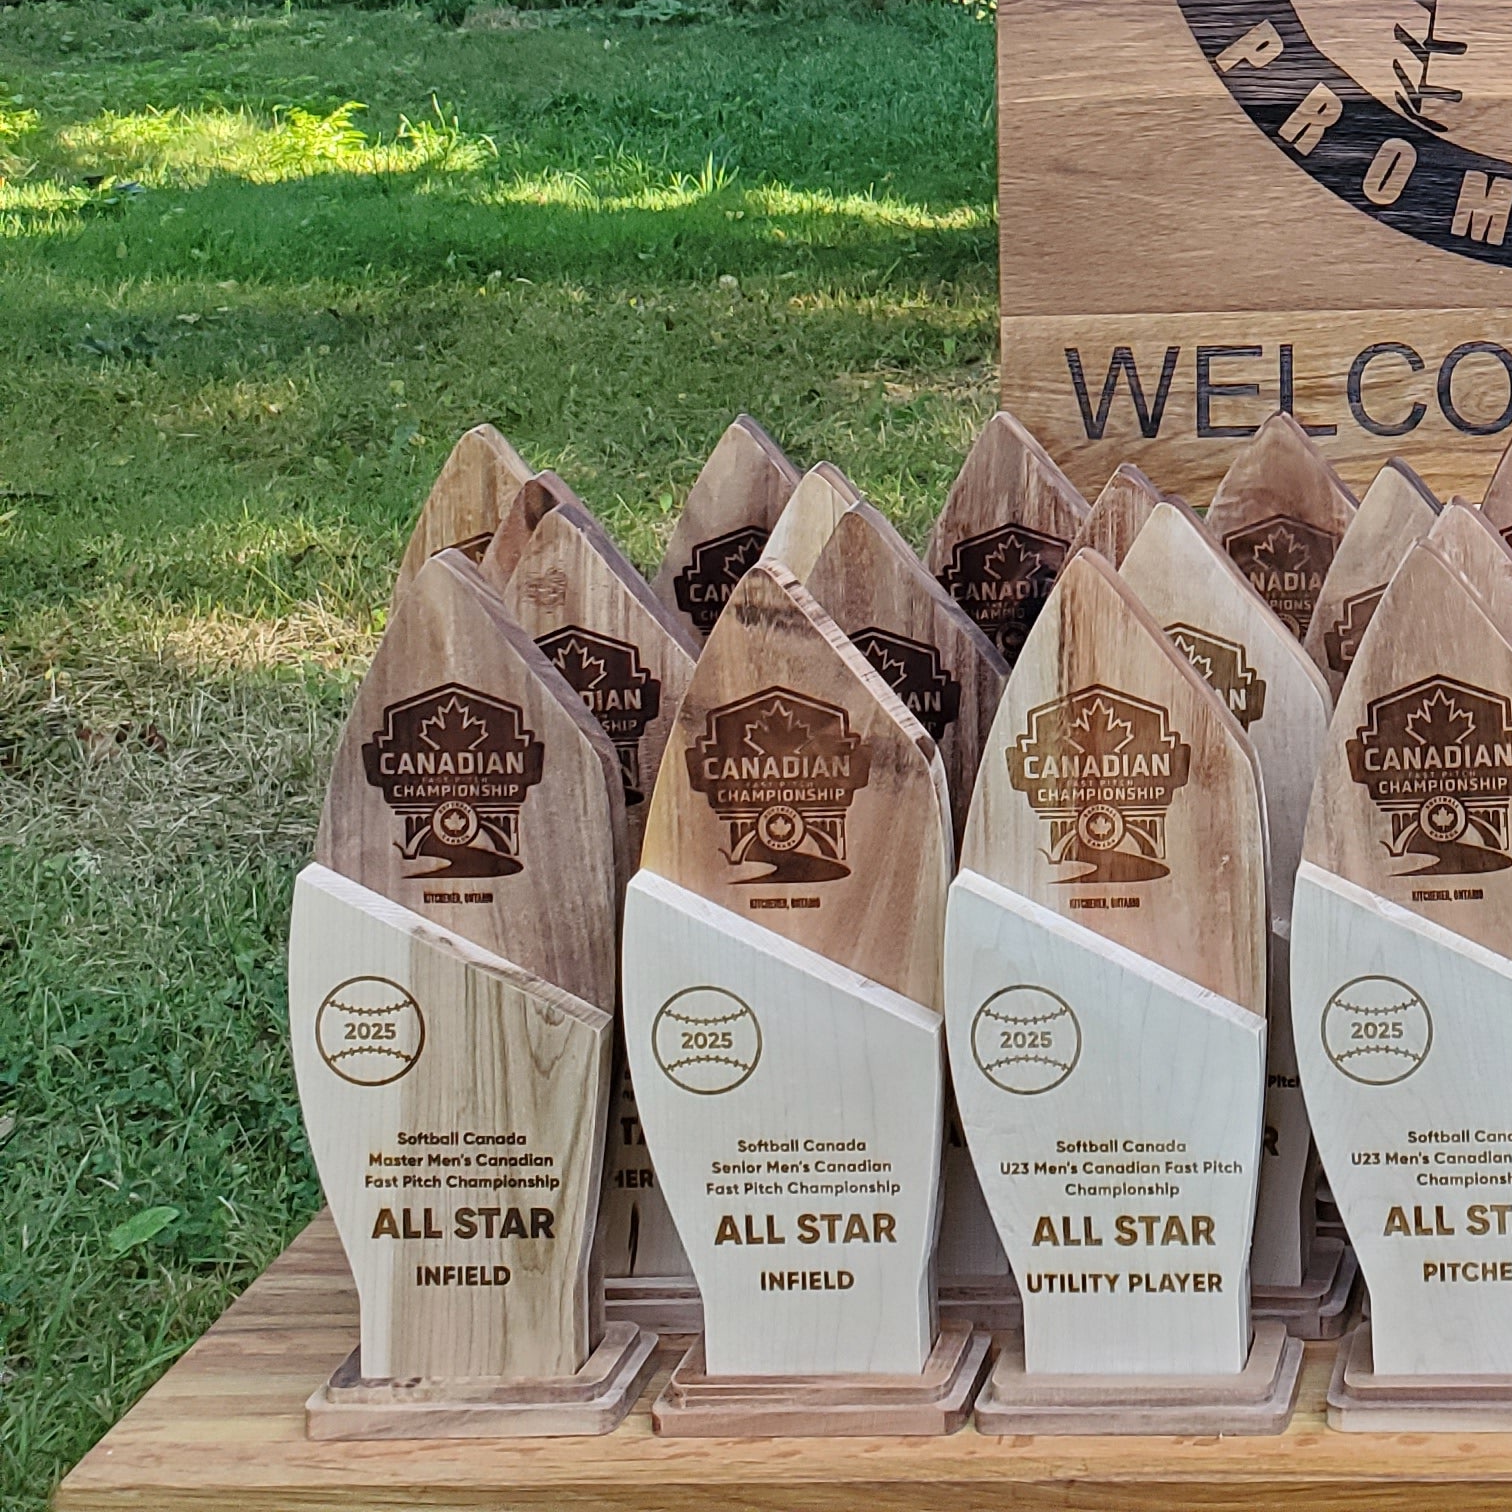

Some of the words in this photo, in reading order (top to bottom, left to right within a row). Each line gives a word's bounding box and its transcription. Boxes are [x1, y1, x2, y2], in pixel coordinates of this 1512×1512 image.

[381, 752, 523, 774] CANADIAN
[1365, 742, 1512, 770] CANADIAN
[704, 756, 849, 779] CANADIAN
[1024, 754, 1170, 781] CANADIAN
[394, 784, 518, 797] CHAMPIONSHIP
[1038, 785, 1164, 802] CHAMPIONSHIP
[1379, 777, 1507, 794] CHAMPIONSHIP
[718, 788, 844, 802] CHAMPIONSHIP
[344, 1022, 396, 1040] 2025
[1351, 1022, 1403, 1039] 2025
[682, 1032, 732, 1049] 2025
[1000, 1031, 1052, 1048] 2025
[398, 1131, 458, 1146] Softball
[463, 1132, 526, 1145] Canada
[1408, 1129, 1469, 1143] Softball
[738, 1139, 799, 1152] Softball
[804, 1138, 866, 1152] Canada
[1056, 1139, 1118, 1153] Softball
[1123, 1140, 1186, 1152] Canada
[370, 1152, 423, 1166] Master
[428, 1154, 471, 1167] Men's
[476, 1153, 553, 1167] Canadian
[1352, 1152, 1380, 1165] U23
[1386, 1152, 1430, 1165] Men's
[1434, 1150, 1512, 1164] Canadian
[712, 1160, 762, 1174] Senior
[767, 1160, 810, 1173] Men's
[815, 1159, 891, 1172] Canadian
[1001, 1162, 1029, 1175] U23
[1034, 1161, 1078, 1175] Men's
[1083, 1161, 1160, 1174] Canadian
[1166, 1162, 1198, 1174] Fast
[1204, 1160, 1242, 1174] Pitch
[365, 1175, 398, 1188] Fast
[403, 1174, 441, 1188] Pitch
[446, 1174, 560, 1191] Championship
[706, 1183, 739, 1195] Fast
[744, 1182, 782, 1194] Pitch
[788, 1180, 900, 1197] Championship
[1065, 1182, 1179, 1198] Championship
[372, 1208, 442, 1239] ALL
[454, 1207, 555, 1239] STAR
[714, 1215, 785, 1245] ALL
[798, 1213, 896, 1244] STAR
[1384, 1206, 1454, 1236] ALL
[1032, 1216, 1102, 1246] ALL
[1114, 1216, 1216, 1246] STAR
[417, 1266, 510, 1286] INFIELD
[761, 1271, 854, 1291] INFIELD
[1027, 1274, 1119, 1293] UTILITY
[1129, 1273, 1222, 1292] PLAYER
